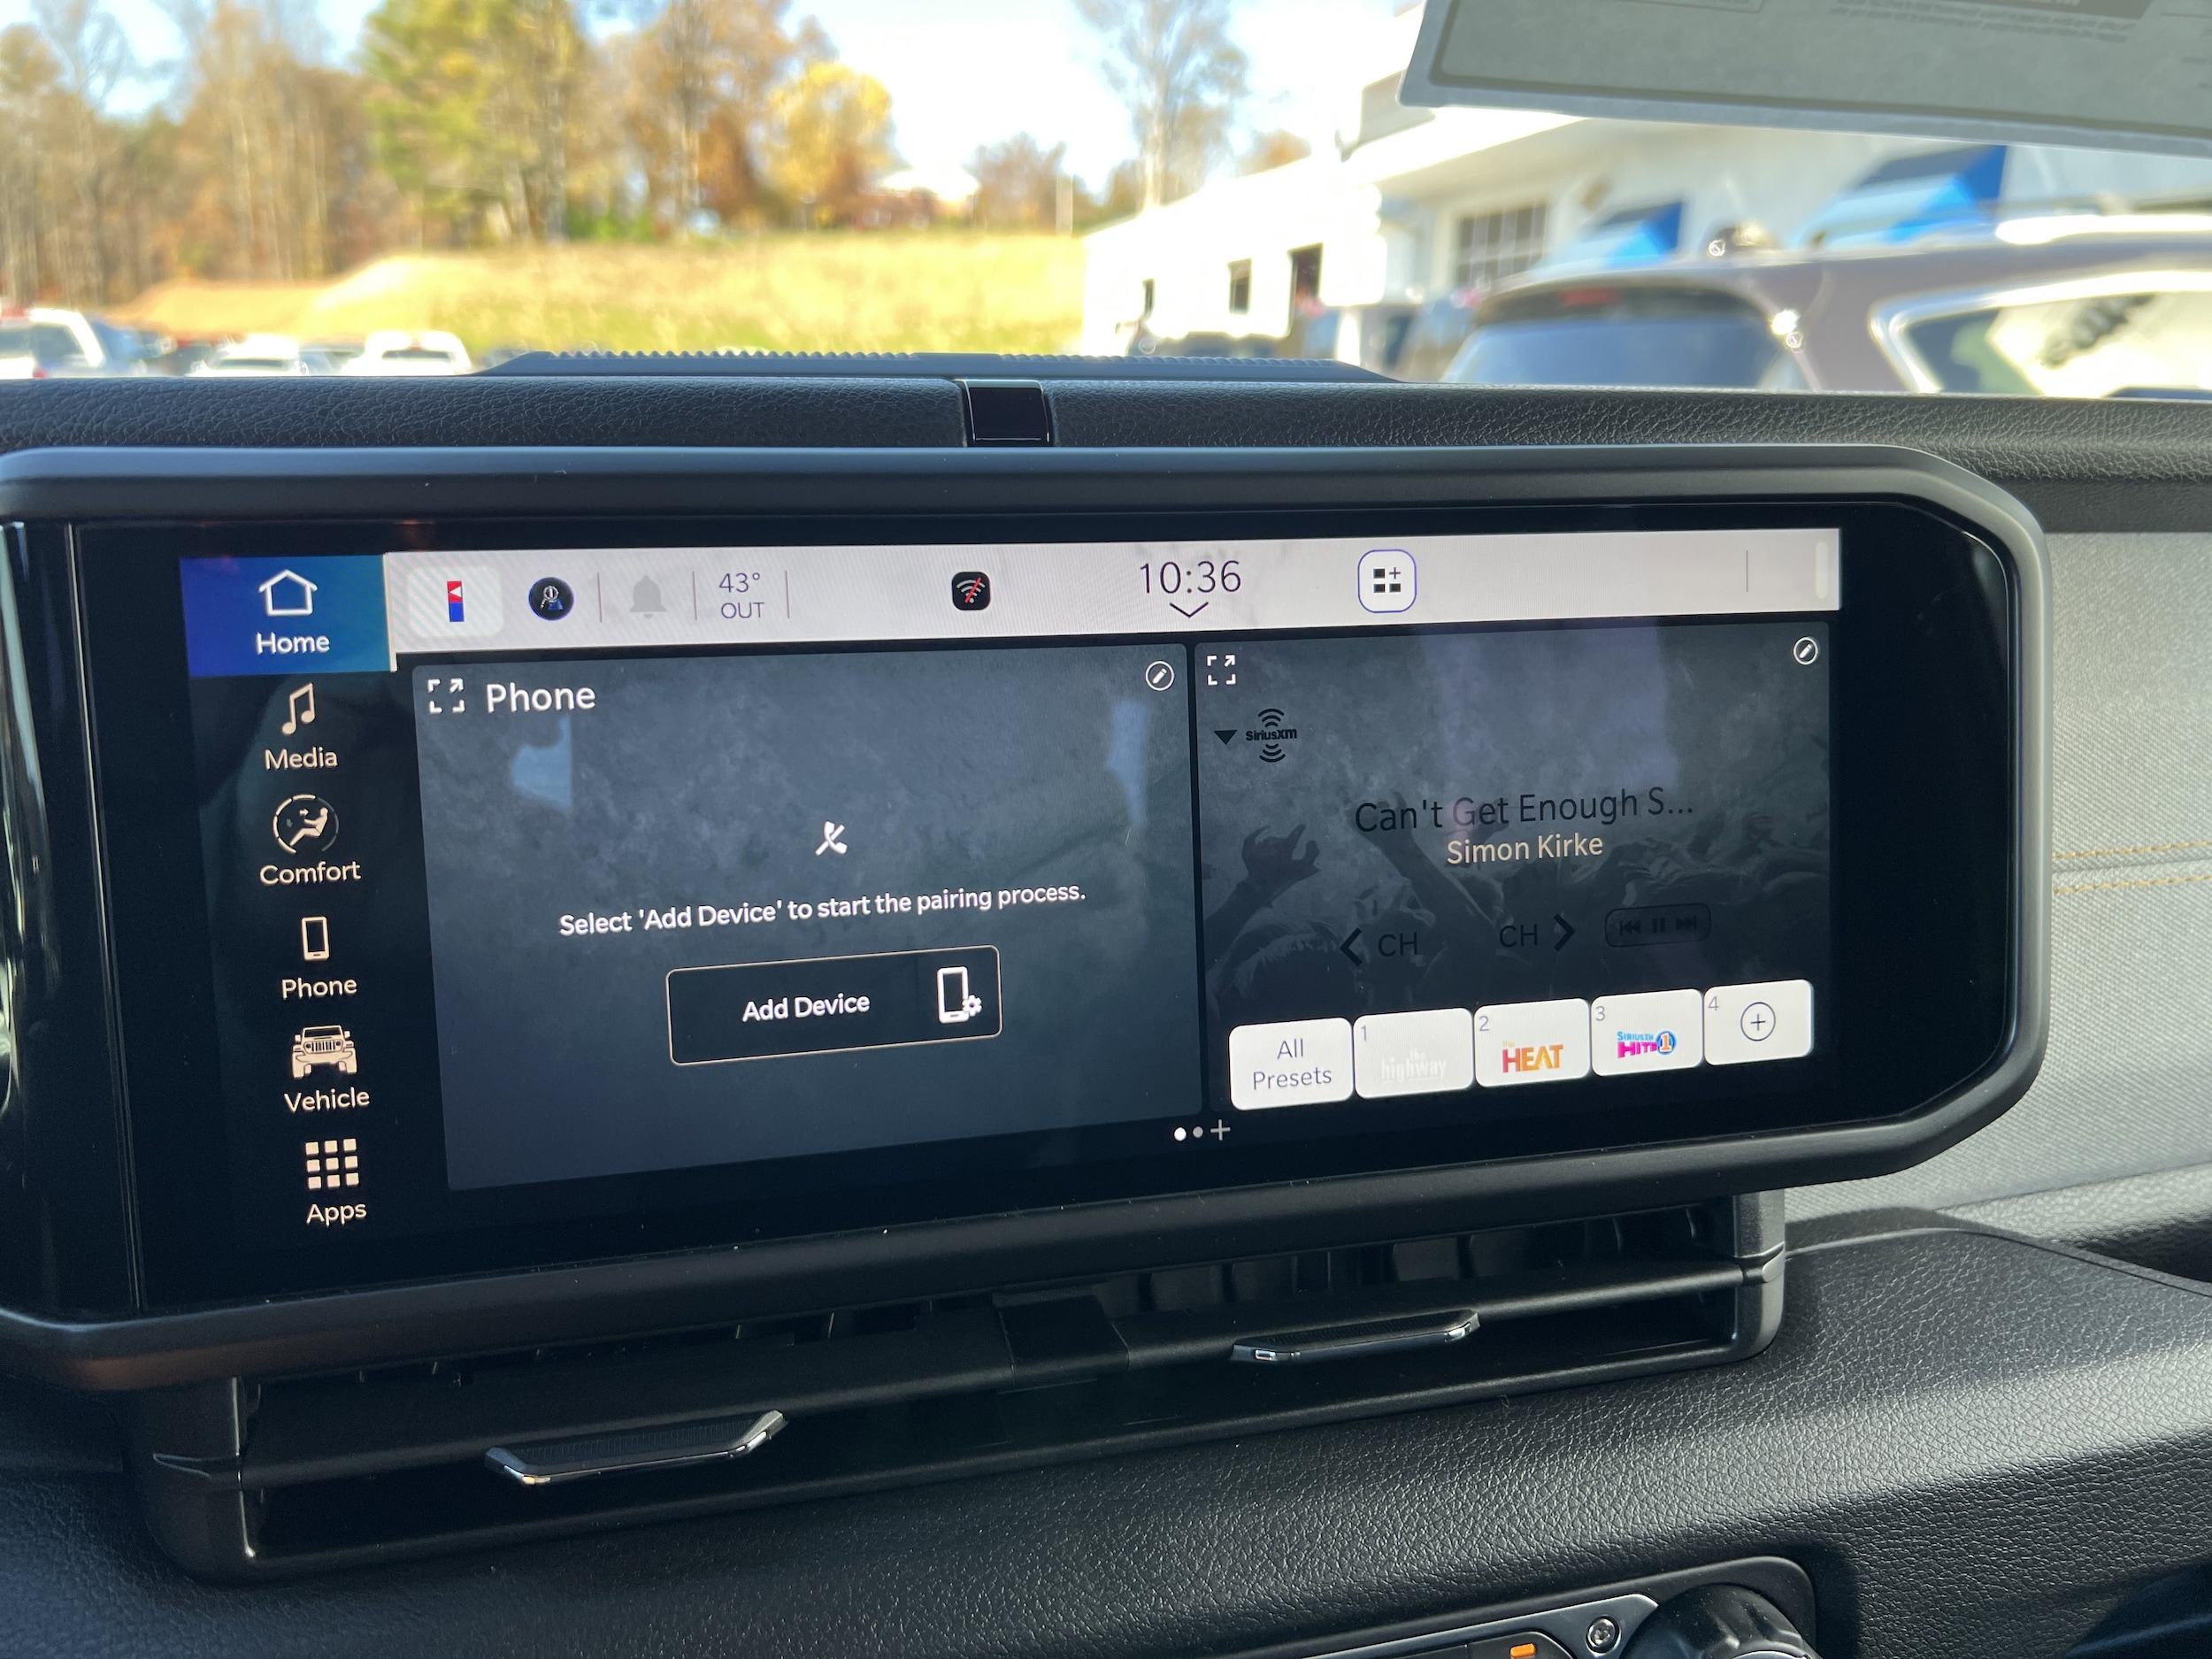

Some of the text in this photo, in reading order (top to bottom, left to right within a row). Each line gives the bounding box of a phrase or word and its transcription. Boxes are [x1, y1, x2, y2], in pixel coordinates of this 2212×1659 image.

[718, 572, 762, 595] 43°
[1139, 559, 1242, 595] 10:36
[719, 602, 766, 620] OUT
[256, 632, 331, 655] Home
[484, 683, 597, 714] Phone
[265, 748, 339, 771] Media
[1355, 799, 1445, 833] Can't
[1451, 794, 1510, 828] Get
[1519, 788, 1639, 825] Enough
[1446, 834, 1605, 866] Simon Kirke
[259, 860, 362, 886] Comfort
[559, 884, 1087, 936] Select 'Add Device' to start the pairing process.
[1377, 932, 1418, 957] CH
[1498, 923, 1539, 949] CH
[280, 976, 358, 1000] Phone
[741, 991, 872, 1023] Add Device
[1595, 1005, 1606, 1022] 3
[1708, 995, 1719, 1012] 4
[1360, 1025, 1369, 1042] 1
[1479, 1015, 1490, 1033] 2
[1277, 1039, 1304, 1059] All
[1502, 1044, 1564, 1073] HEAT
[1252, 1066, 1333, 1091] Presets
[1381, 1059, 1448, 1083] highway
[283, 1087, 370, 1113] Vehicle
[306, 1202, 367, 1225] Apps
